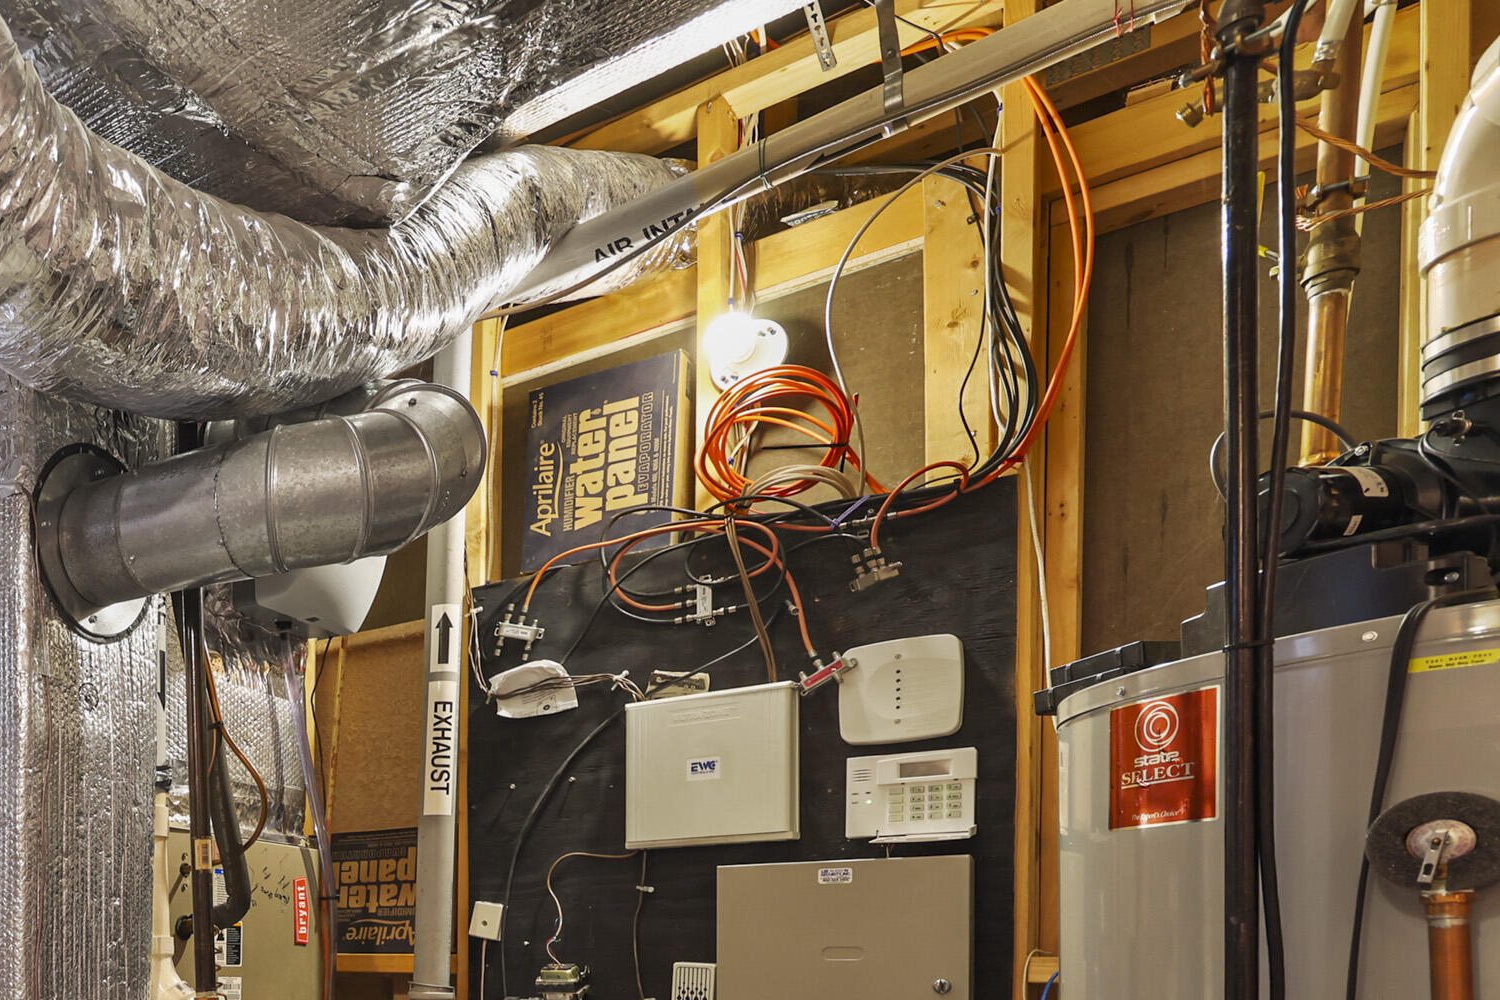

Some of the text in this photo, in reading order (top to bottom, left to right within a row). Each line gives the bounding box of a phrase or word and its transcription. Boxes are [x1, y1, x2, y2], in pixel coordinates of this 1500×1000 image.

[594, 236, 634, 263] AIR
[603, 396, 649, 512] panel
[637, 391, 654, 493] EVAPORATOR
[529, 441, 558, 537] Aprilaire
[569, 409, 607, 531] water
[563, 476, 575, 532] HUMIDIFIER
[430, 701, 453, 795] EXHAUST
[1134, 750, 1181, 768] state
[1121, 761, 1195, 786] SELECT
[332, 846, 417, 890] panel
[297, 885, 308, 934] bryant
[338, 883, 417, 913] water
[346, 920, 415, 946] Aprilaire
